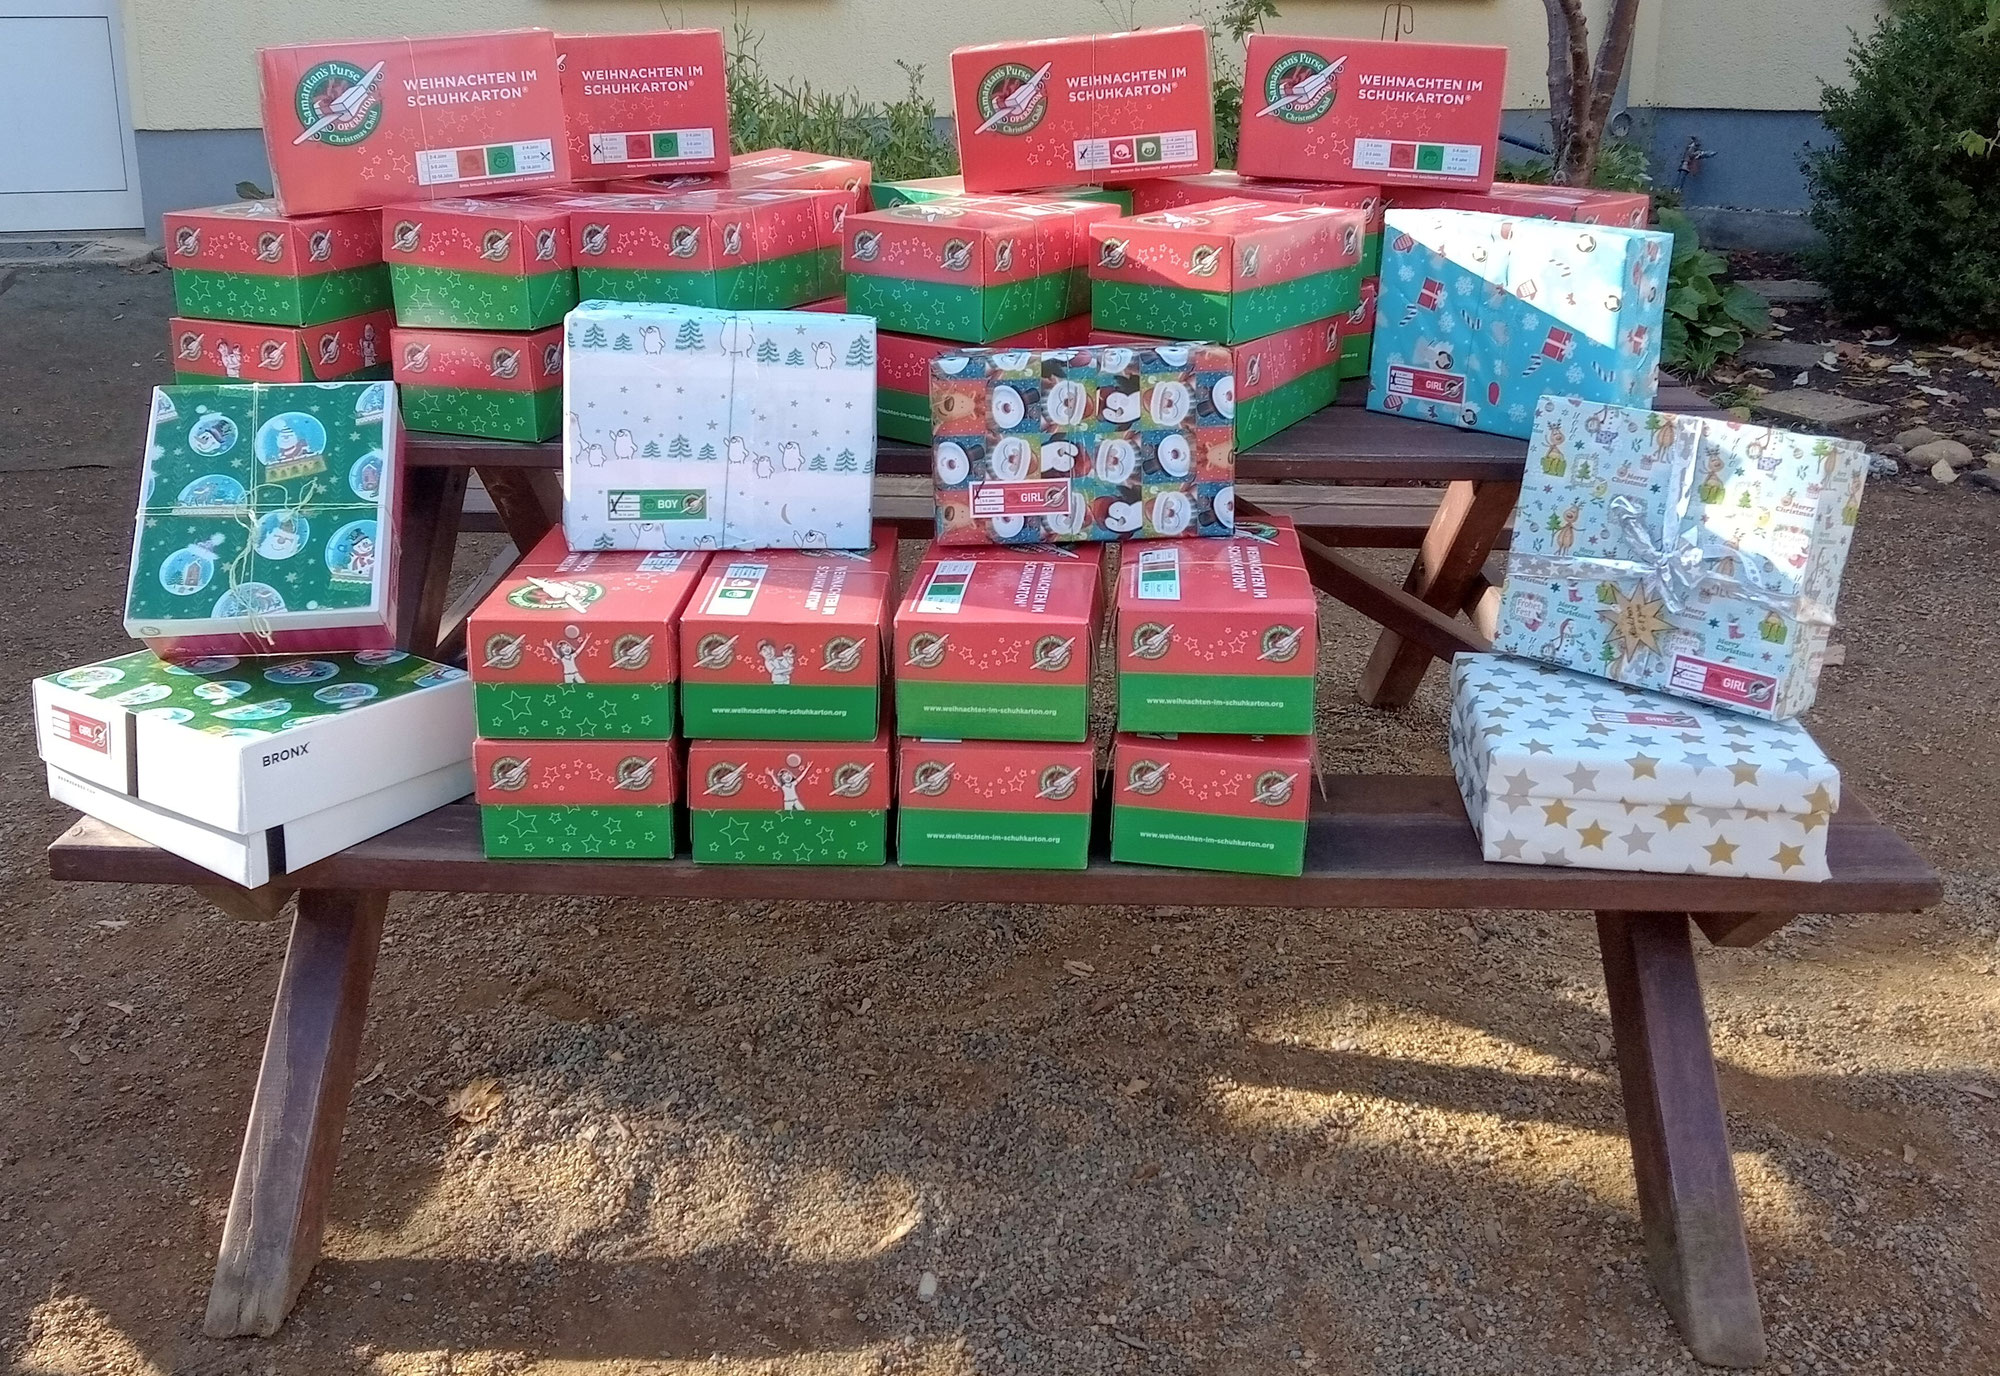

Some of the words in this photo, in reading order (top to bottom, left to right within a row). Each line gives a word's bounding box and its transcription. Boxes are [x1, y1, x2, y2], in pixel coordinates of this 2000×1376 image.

[403, 71, 516, 90] WEIHNACHTEN
[521, 69, 537, 81] IM
[581, 66, 683, 81] WEIHNACHTEN
[688, 65, 703, 77] IM
[1066, 68, 1167, 88] WEIHNACHTEN
[1171, 66, 1187, 78] IM
[1268, 55, 1299, 102] Samaritan's
[1300, 52, 1324, 71] Purse
[1358, 74, 1462, 91] WEIHNACHTEN
[1466, 79, 1483, 91] IM
[300, 67, 329, 125] Samaritan's
[329, 63, 360, 82] Purse
[982, 69, 1005, 118] Samaritan's
[1005, 65, 1031, 80] Purse
[1294, 84, 1332, 111] OPERATION
[337, 96, 376, 130] OPERATION
[329, 130, 368, 143] Christmas
[364, 110, 378, 130] Child
[1425, 380, 1444, 391] GIRL
[657, 499, 679, 509] BOY
[1020, 492, 1044, 503] GIRL
[1775, 505, 1815, 518] Christmas
[1792, 502, 1816, 513] Merry
[1246, 546, 1266, 589] WEIHNACHTEN
[1034, 562, 1056, 604] WEIHNACHTEN
[1517, 599, 1542, 611] Frohes
[1558, 601, 1580, 611] Merry
[1516, 608, 1532, 617] Fest
[1556, 607, 1592, 620] Christmas
[1717, 638, 1742, 649] Merry
[1715, 645, 1755, 659] Christmas
[1722, 677, 1748, 692] GIRL
[1146, 697, 1285, 708] www.weihnachten-im-schuhkarton.org
[711, 707, 848, 717] www.weihnachten-im-schuhkarton.org
[923, 705, 1058, 716] www.weihnachten-im-schuhkarton.org
[78, 724, 94, 738] GIRL
[262, 741, 311, 767] BRONX
[926, 832, 1061, 844] www.weihnachten-im-schuhkarton.org
[1139, 831, 1275, 849] www.weihnachten-im-schuhkarton.org
